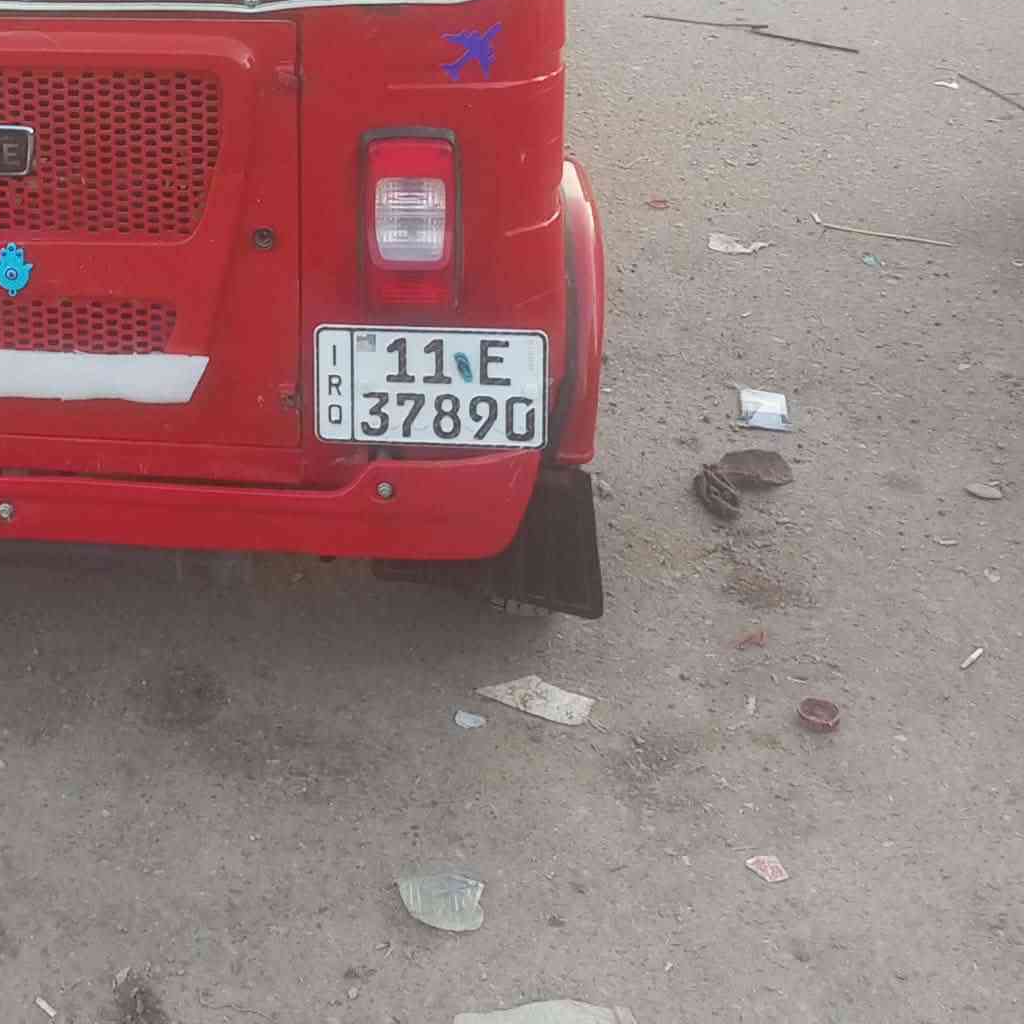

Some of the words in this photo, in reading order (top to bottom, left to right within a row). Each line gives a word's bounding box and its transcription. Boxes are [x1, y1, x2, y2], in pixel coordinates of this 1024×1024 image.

[386, 337, 453, 385] 11
[479, 339, 512, 387] E
[360, 391, 536, 442] 37890
